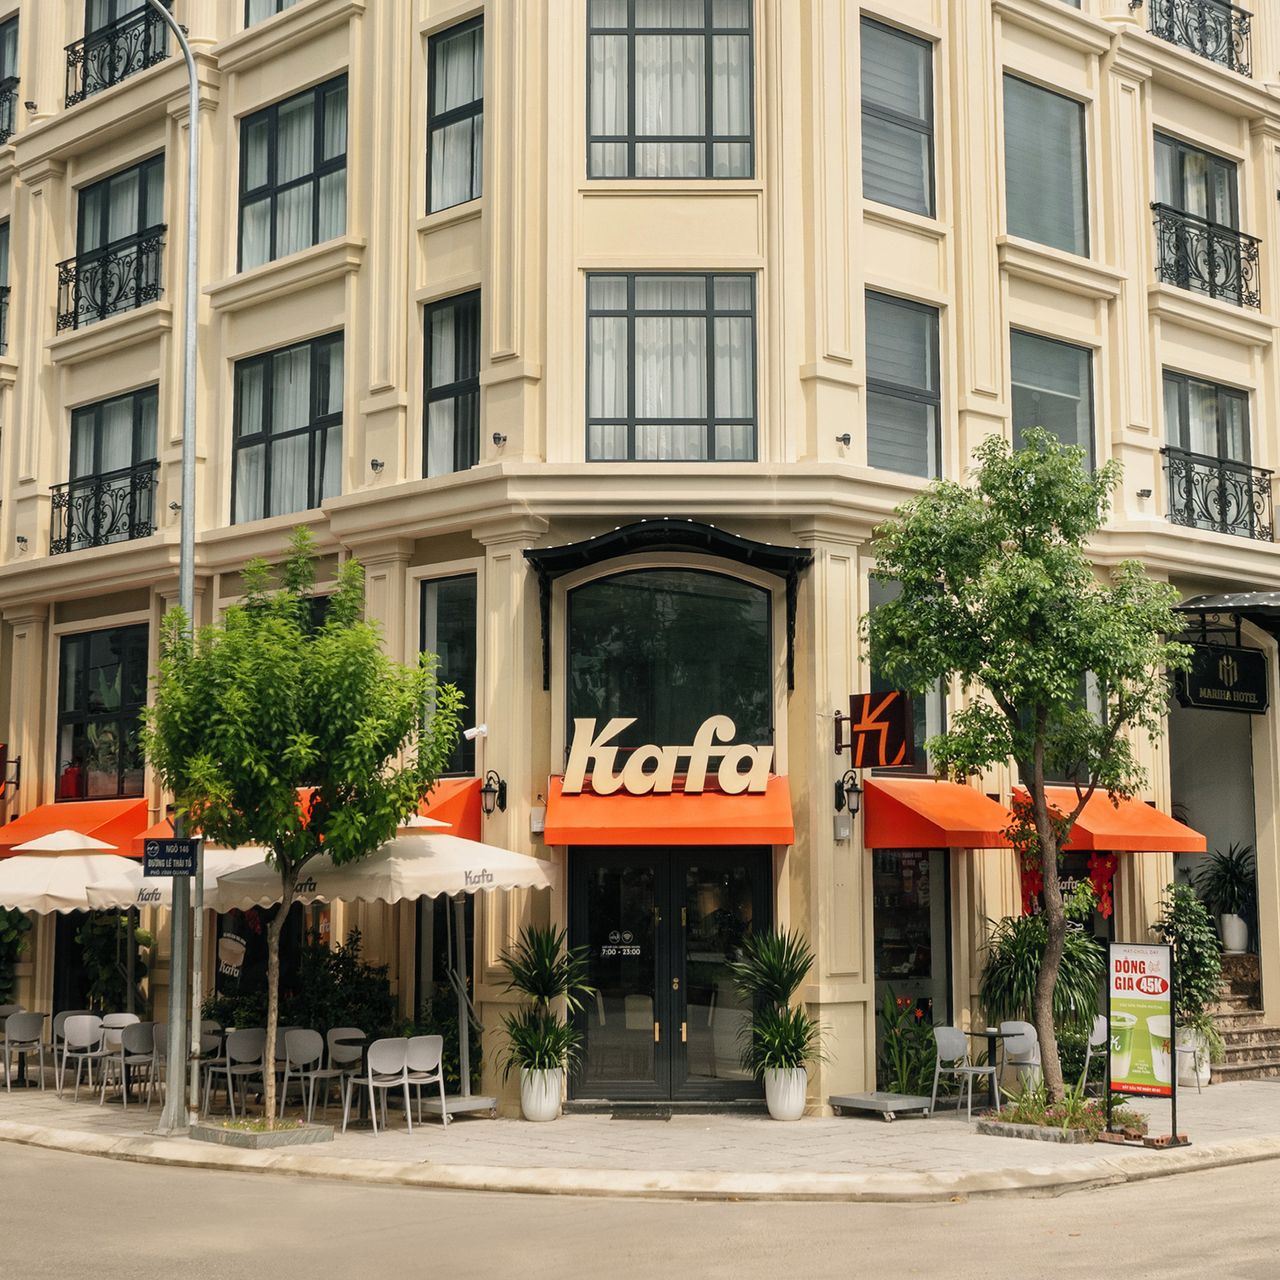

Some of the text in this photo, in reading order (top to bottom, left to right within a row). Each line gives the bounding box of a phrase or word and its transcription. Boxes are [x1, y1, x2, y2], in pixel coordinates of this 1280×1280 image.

[1233, 691, 1258, 703] HOTEL
[561, 714, 774, 796] Kafa
[293, 877, 317, 893] afa
[464, 868, 493, 886] Kafa
[137, 888, 162, 902] Kafa
[1140, 976, 1163, 993] 45K
